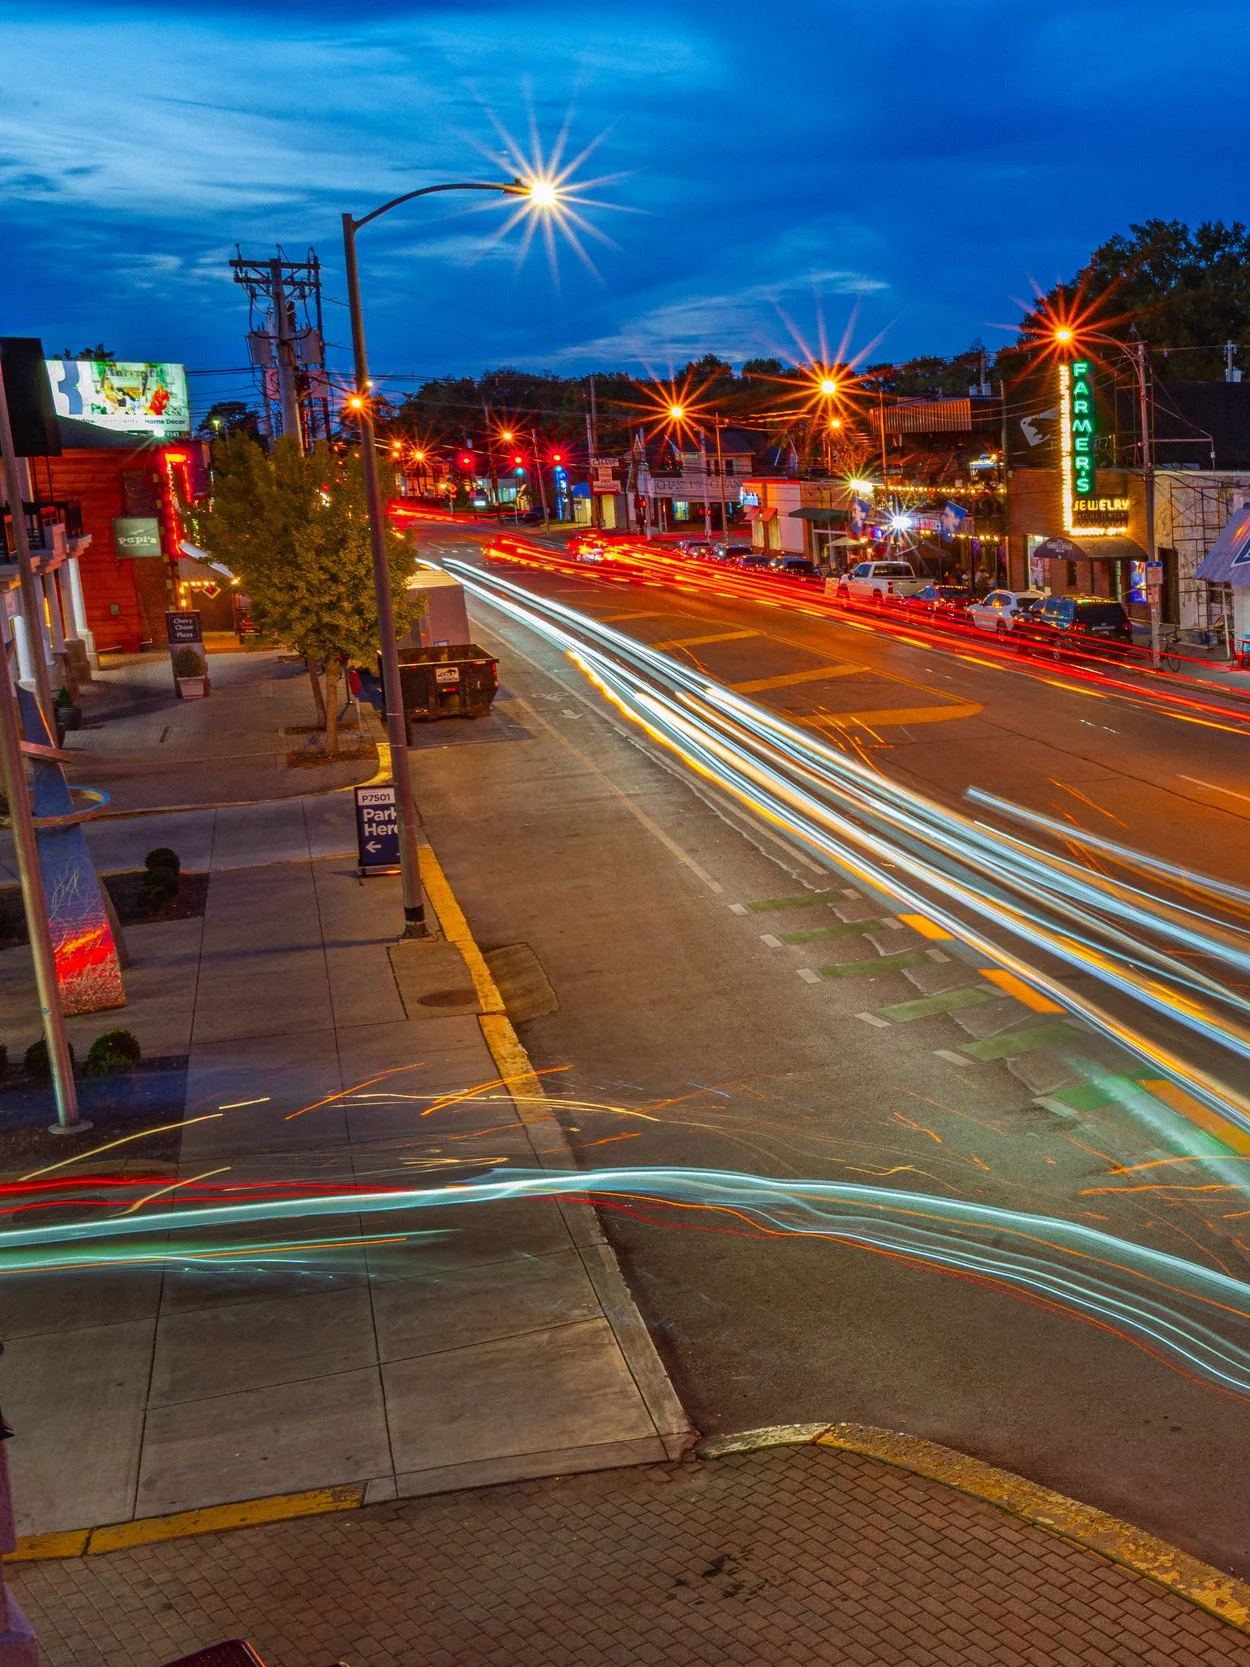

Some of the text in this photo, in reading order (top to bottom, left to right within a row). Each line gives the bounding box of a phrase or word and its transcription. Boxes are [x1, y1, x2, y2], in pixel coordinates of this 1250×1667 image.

[1071, 362, 1092, 493] FARMER'S
[1073, 499, 1129, 511] JEWELRY
[118, 535, 157, 545] papi's
[362, 794, 390, 802] P7501
[363, 807, 397, 822] Park
